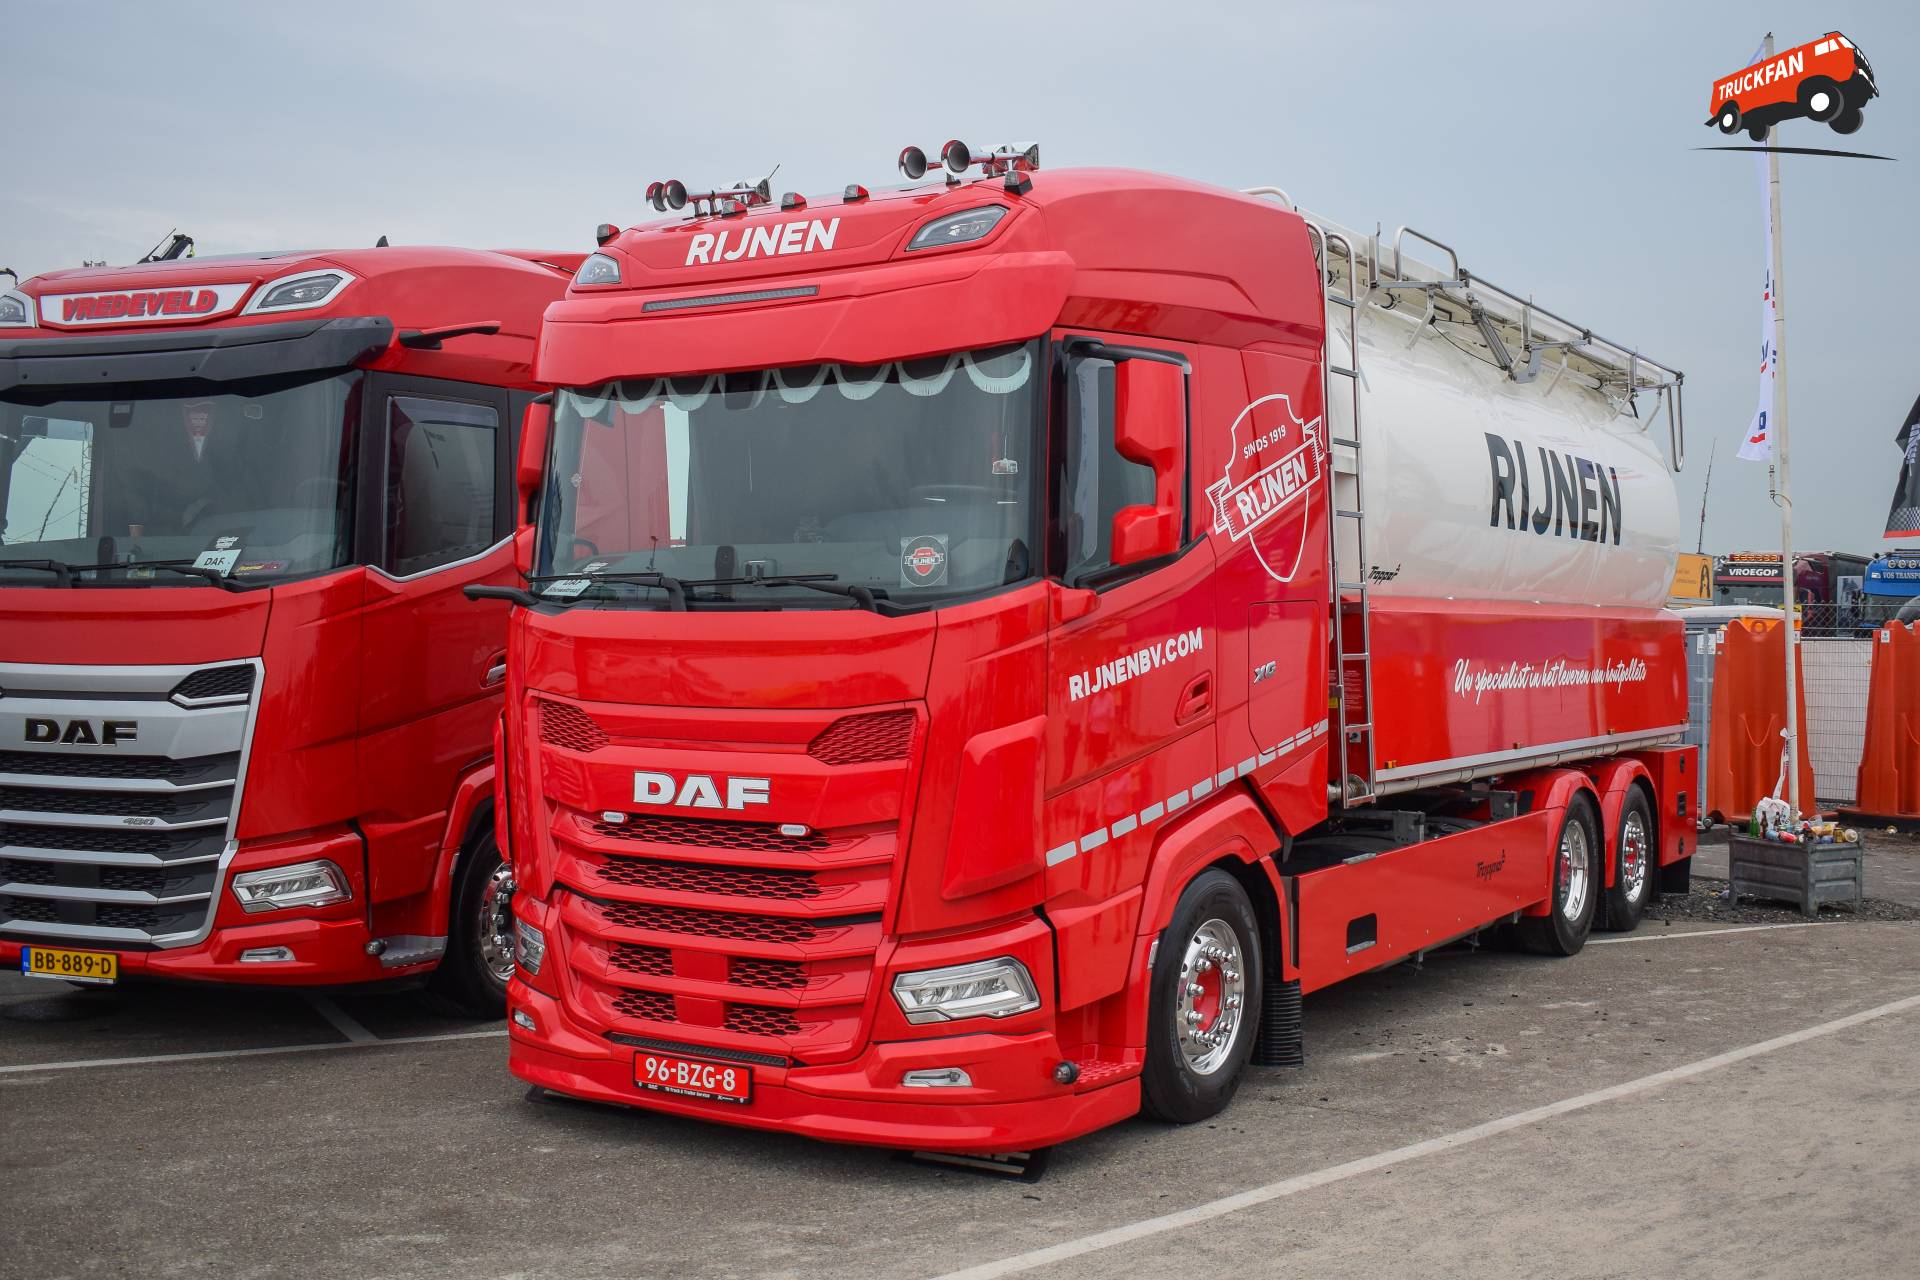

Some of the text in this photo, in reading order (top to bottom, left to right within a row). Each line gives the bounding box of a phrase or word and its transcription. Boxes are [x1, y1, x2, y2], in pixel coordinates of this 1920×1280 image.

[685, 217, 841, 267] RIJNEN
[62, 289, 218, 322] VREDEVELD
[1243, 424, 1287, 459] SINDS 1919
[1235, 452, 1308, 526] RIJNEN
[1484, 432, 1622, 546] RIJNEN
[1729, 568, 1778, 577] VROEGOP
[1882, 571, 1896, 579] VOS
[1069, 627, 1204, 702] RIJNENBV.COM
[1475, 661, 1531, 705] specialist
[1530, 665, 1541, 688] in
[1541, 659, 1559, 687] het
[1559, 659, 1590, 685] leveren
[1605, 657, 1647, 694] houtpellets
[25, 718, 138, 746] DAF
[632, 769, 771, 811] DAF
[34, 951, 112, 975] BB-889-D
[645, 1057, 736, 1092] 96-BZG-8
